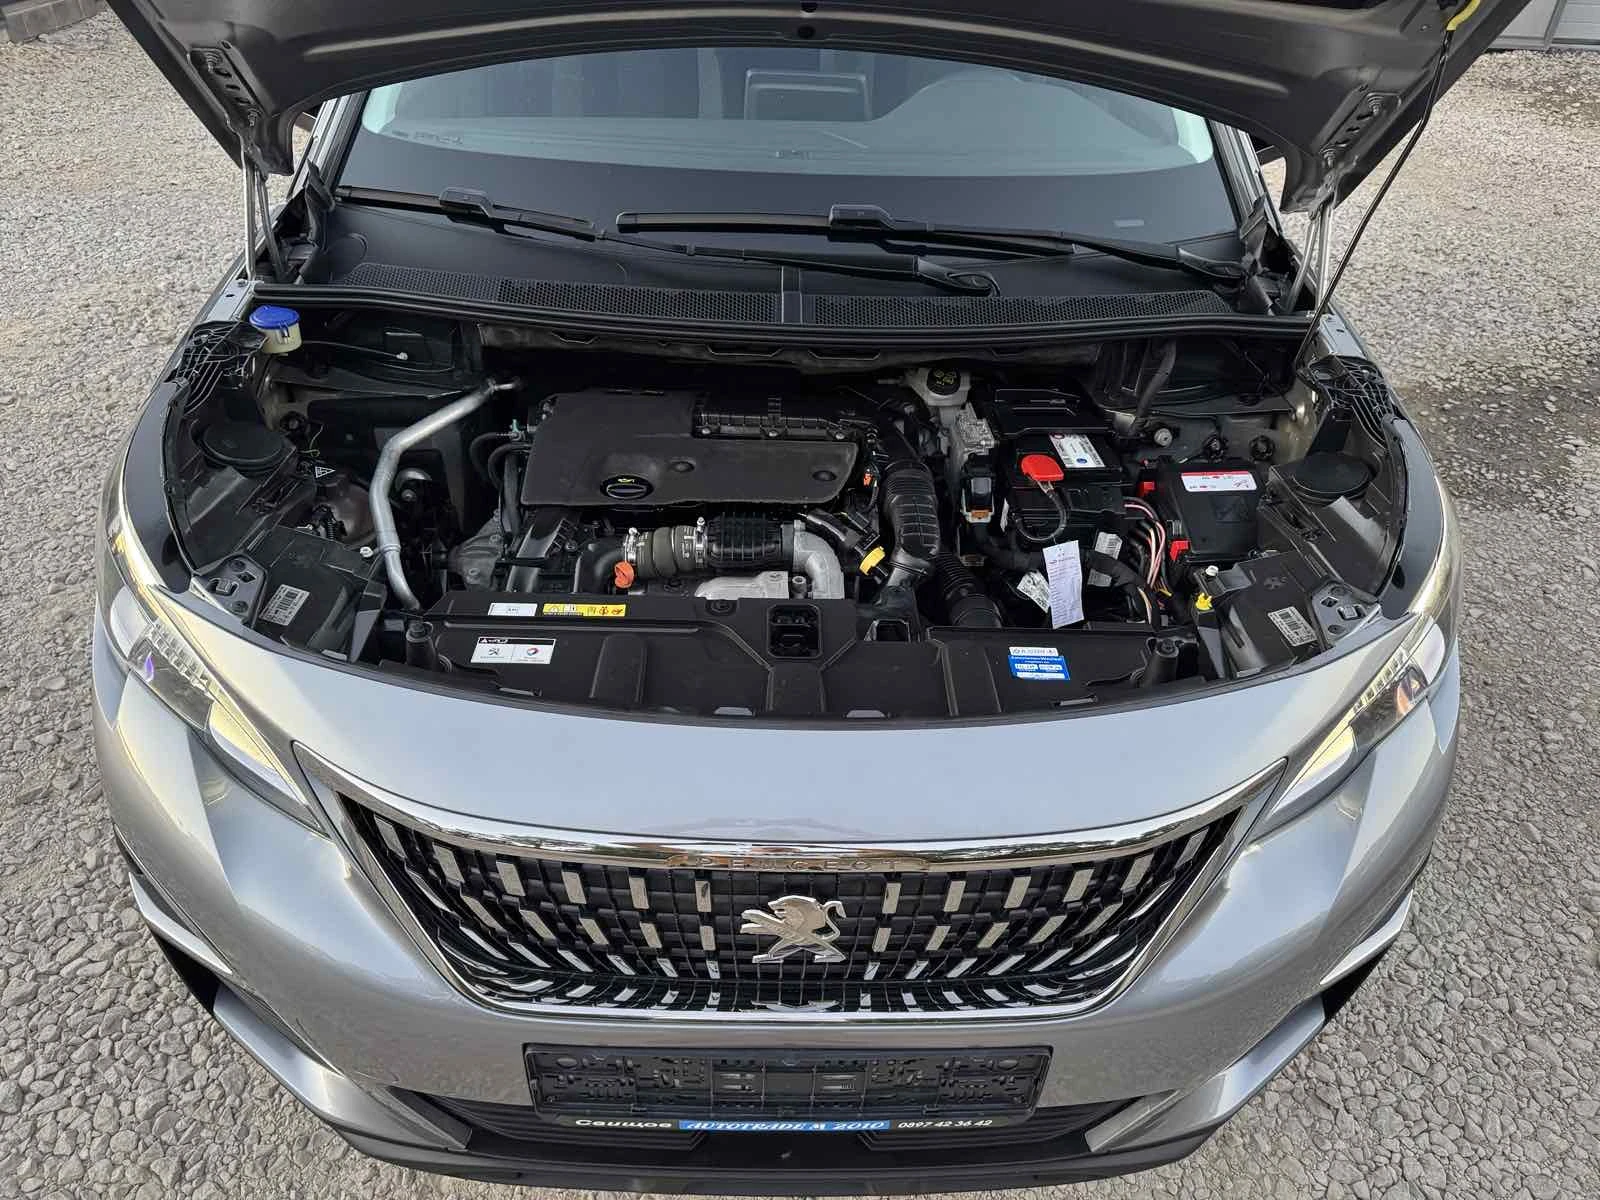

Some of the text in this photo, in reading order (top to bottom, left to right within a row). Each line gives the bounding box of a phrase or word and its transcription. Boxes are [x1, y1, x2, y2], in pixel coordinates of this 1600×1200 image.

[687, 1121, 806, 1130] AUTOTRADE
[832, 1121, 886, 1130] 2010
[897, 1121, 933, 1129] 0897
